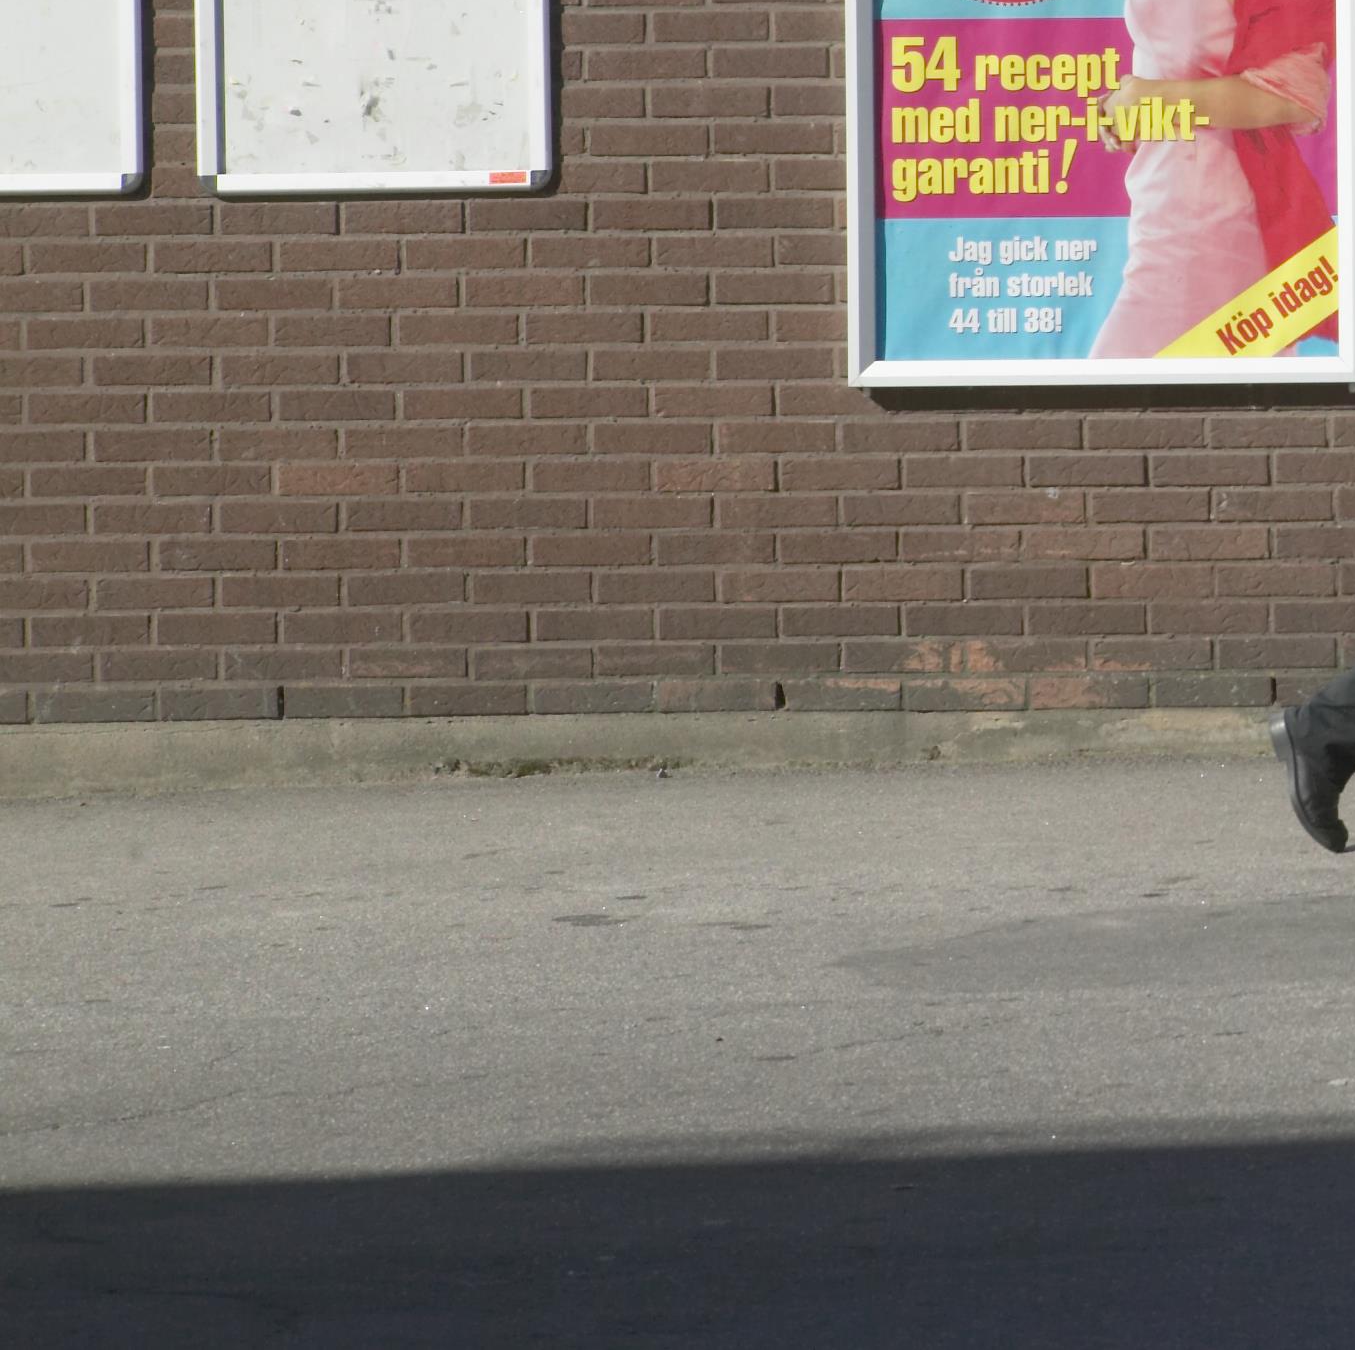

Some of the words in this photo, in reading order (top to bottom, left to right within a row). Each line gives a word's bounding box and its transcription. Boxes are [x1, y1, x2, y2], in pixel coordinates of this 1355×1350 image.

[891, 36, 961, 92] 54
[975, 48, 1120, 98] recept
[891, 98, 980, 143] med
[994, 97, 1210, 143] ner-i-vikt-
[892, 138, 1078, 202] garanti!
[949, 236, 992, 266] Jag
[1000, 236, 1048, 266] gick
[1055, 240, 1097, 261] ner
[949, 267, 1000, 298] från
[1007, 271, 1093, 297] storlek
[1216, 311, 1274, 355] Köp
[1268, 255, 1338, 319] idag!
[949, 308, 981, 333] 44
[987, 307, 1017, 333] till
[1024, 307, 1063, 333] 38!
